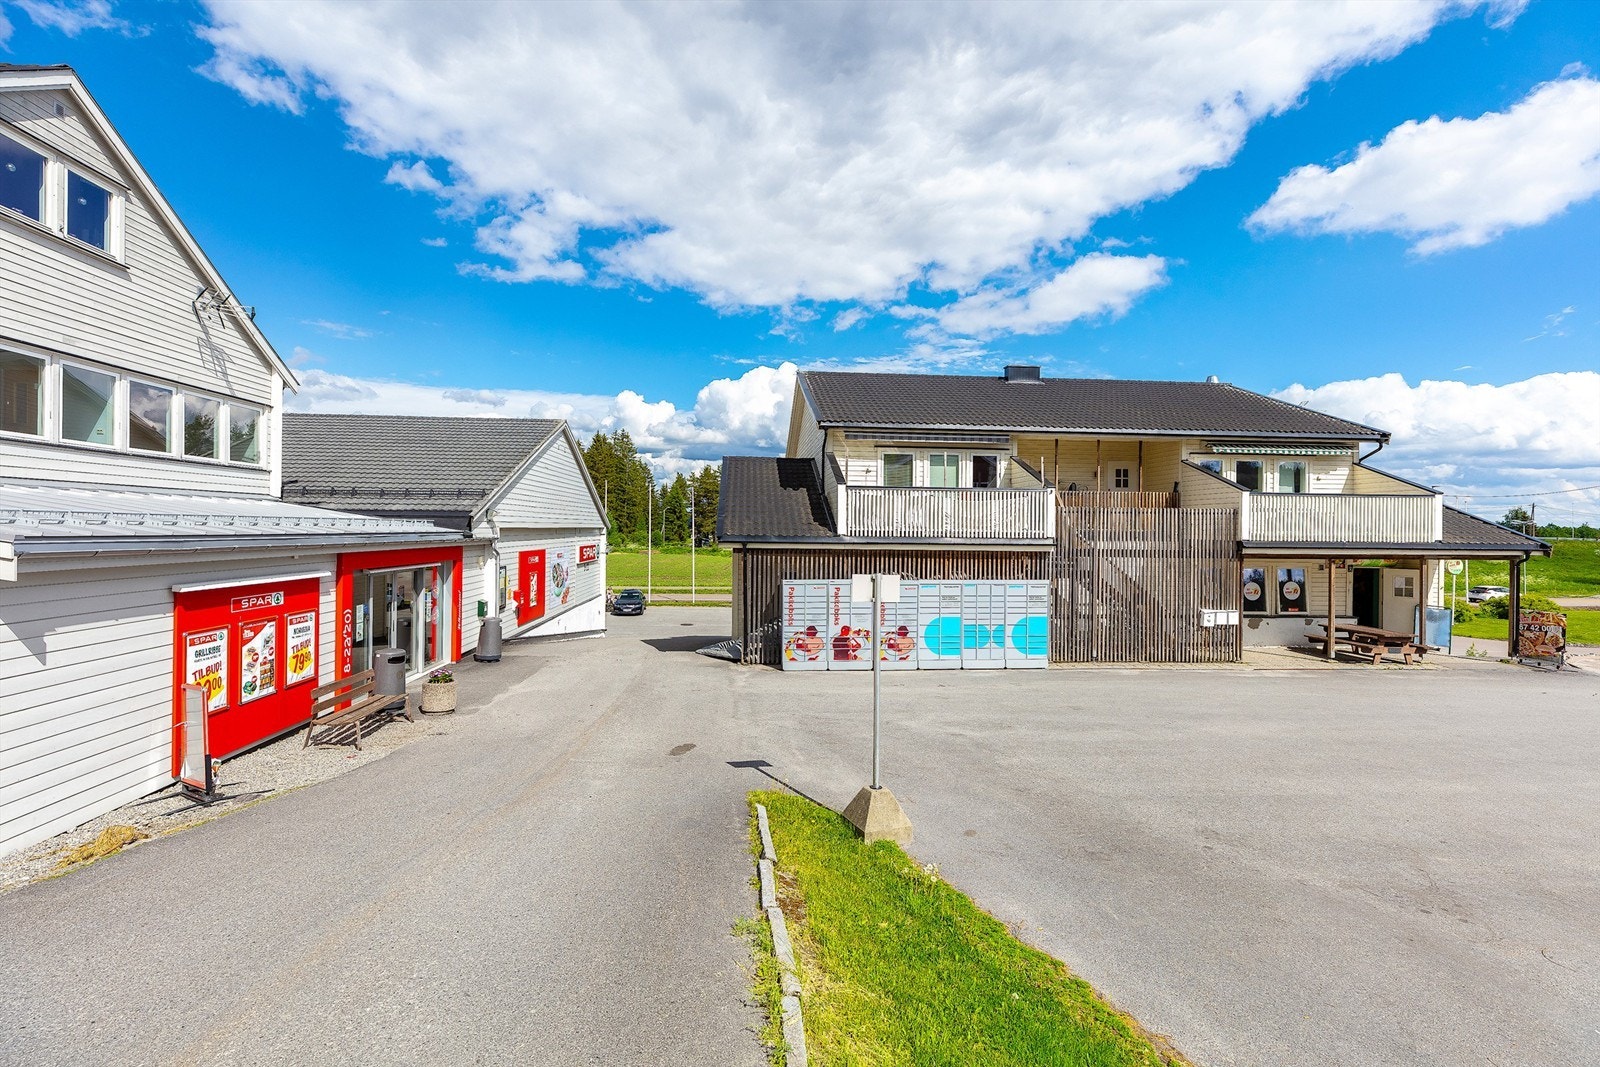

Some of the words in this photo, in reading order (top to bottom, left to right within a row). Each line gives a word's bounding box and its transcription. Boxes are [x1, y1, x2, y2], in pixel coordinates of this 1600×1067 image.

[582, 547, 597, 560] SPAR
[241, 594, 272, 609] SPAR
[194, 635, 218, 645] SPAR
[192, 661, 222, 682] TILBUD!
